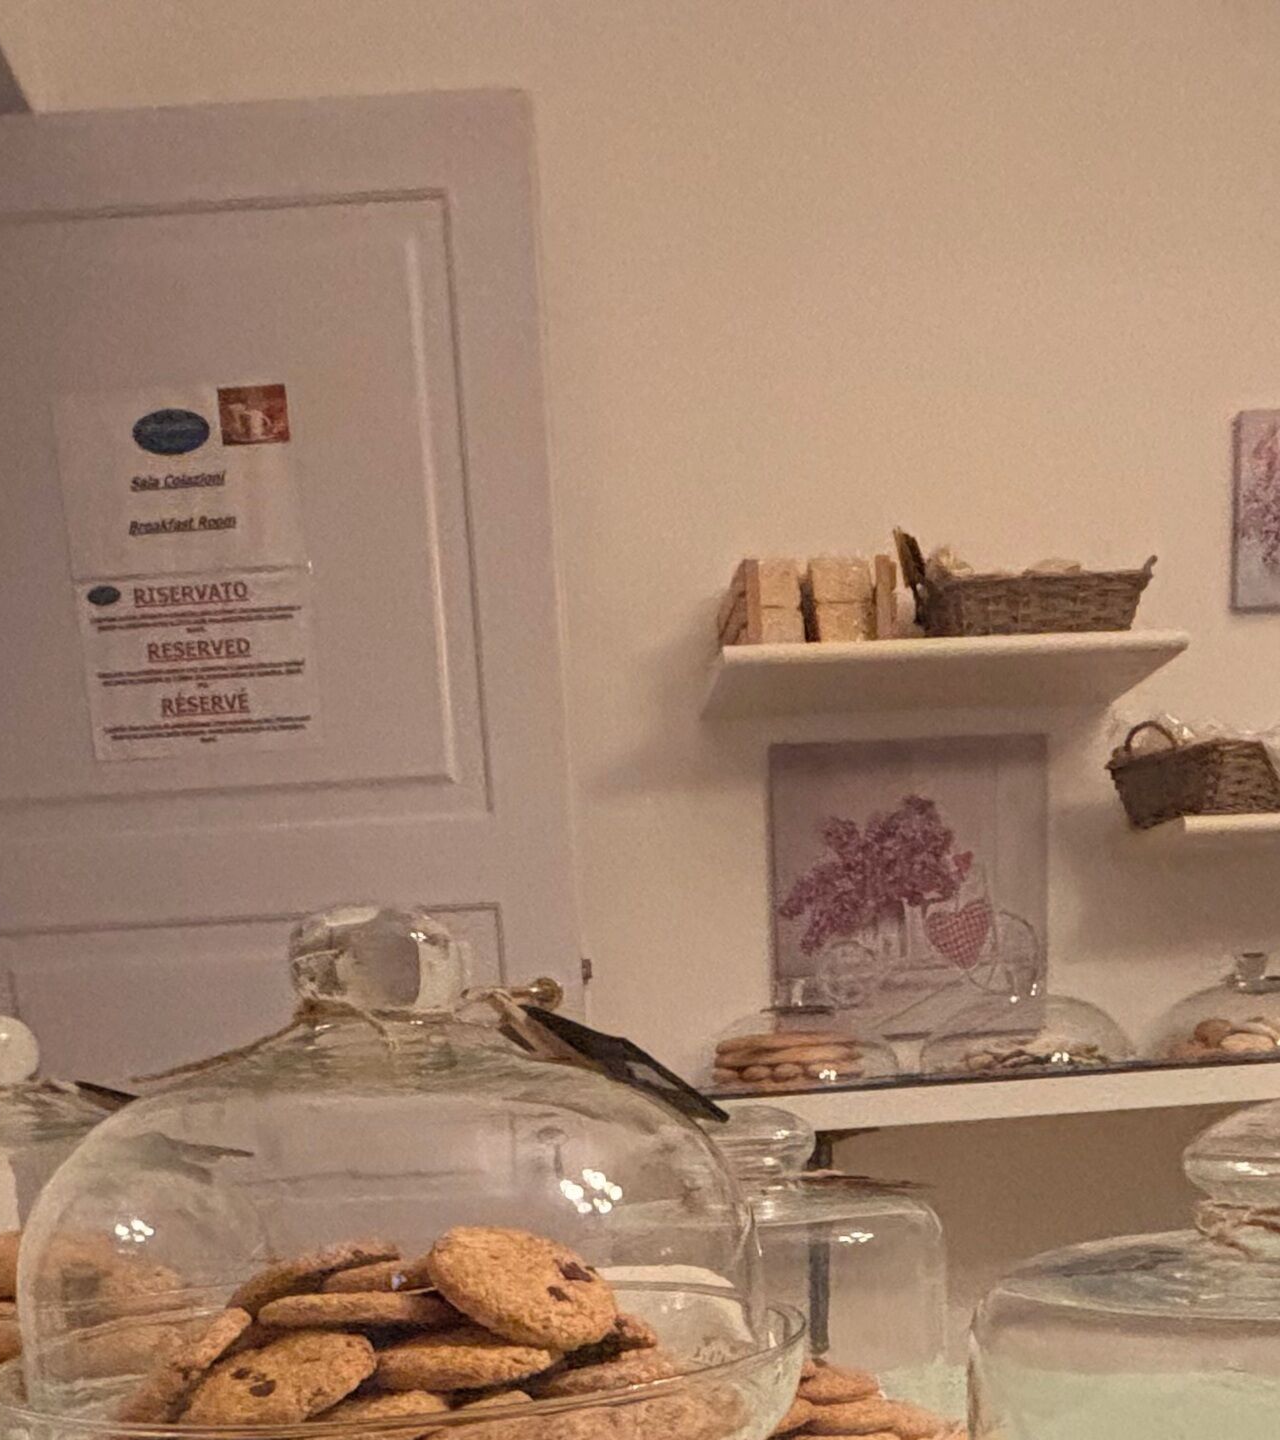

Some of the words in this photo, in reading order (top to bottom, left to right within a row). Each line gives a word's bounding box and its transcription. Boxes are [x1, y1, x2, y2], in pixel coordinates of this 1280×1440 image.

[129, 518, 194, 536] Breakfast
[133, 582, 250, 608] RISERVATO
[146, 638, 251, 662] RESERVED
[160, 688, 250, 717] RÉSERVÉ
